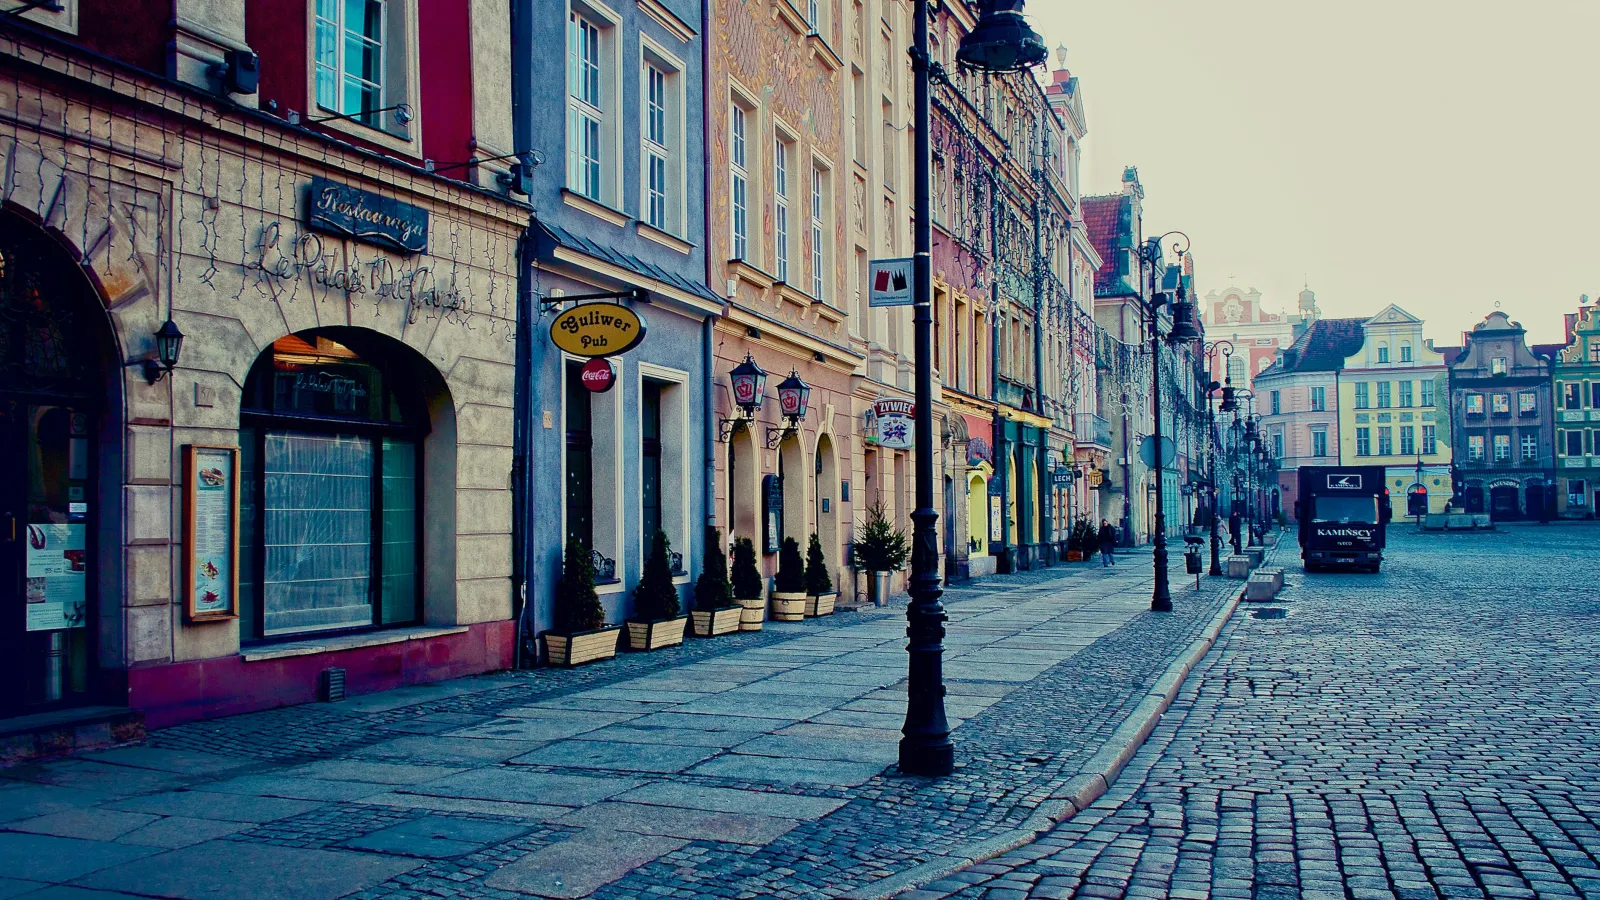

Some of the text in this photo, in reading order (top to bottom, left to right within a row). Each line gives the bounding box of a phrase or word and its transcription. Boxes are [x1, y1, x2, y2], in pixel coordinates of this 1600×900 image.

[248, 222, 292, 281] Le
[560, 311, 631, 334] Guliwer
[580, 335, 608, 349] Pub
[879, 401, 914, 414] ŻYWIEC
[1317, 528, 1371, 537] KAMIŃSCY
